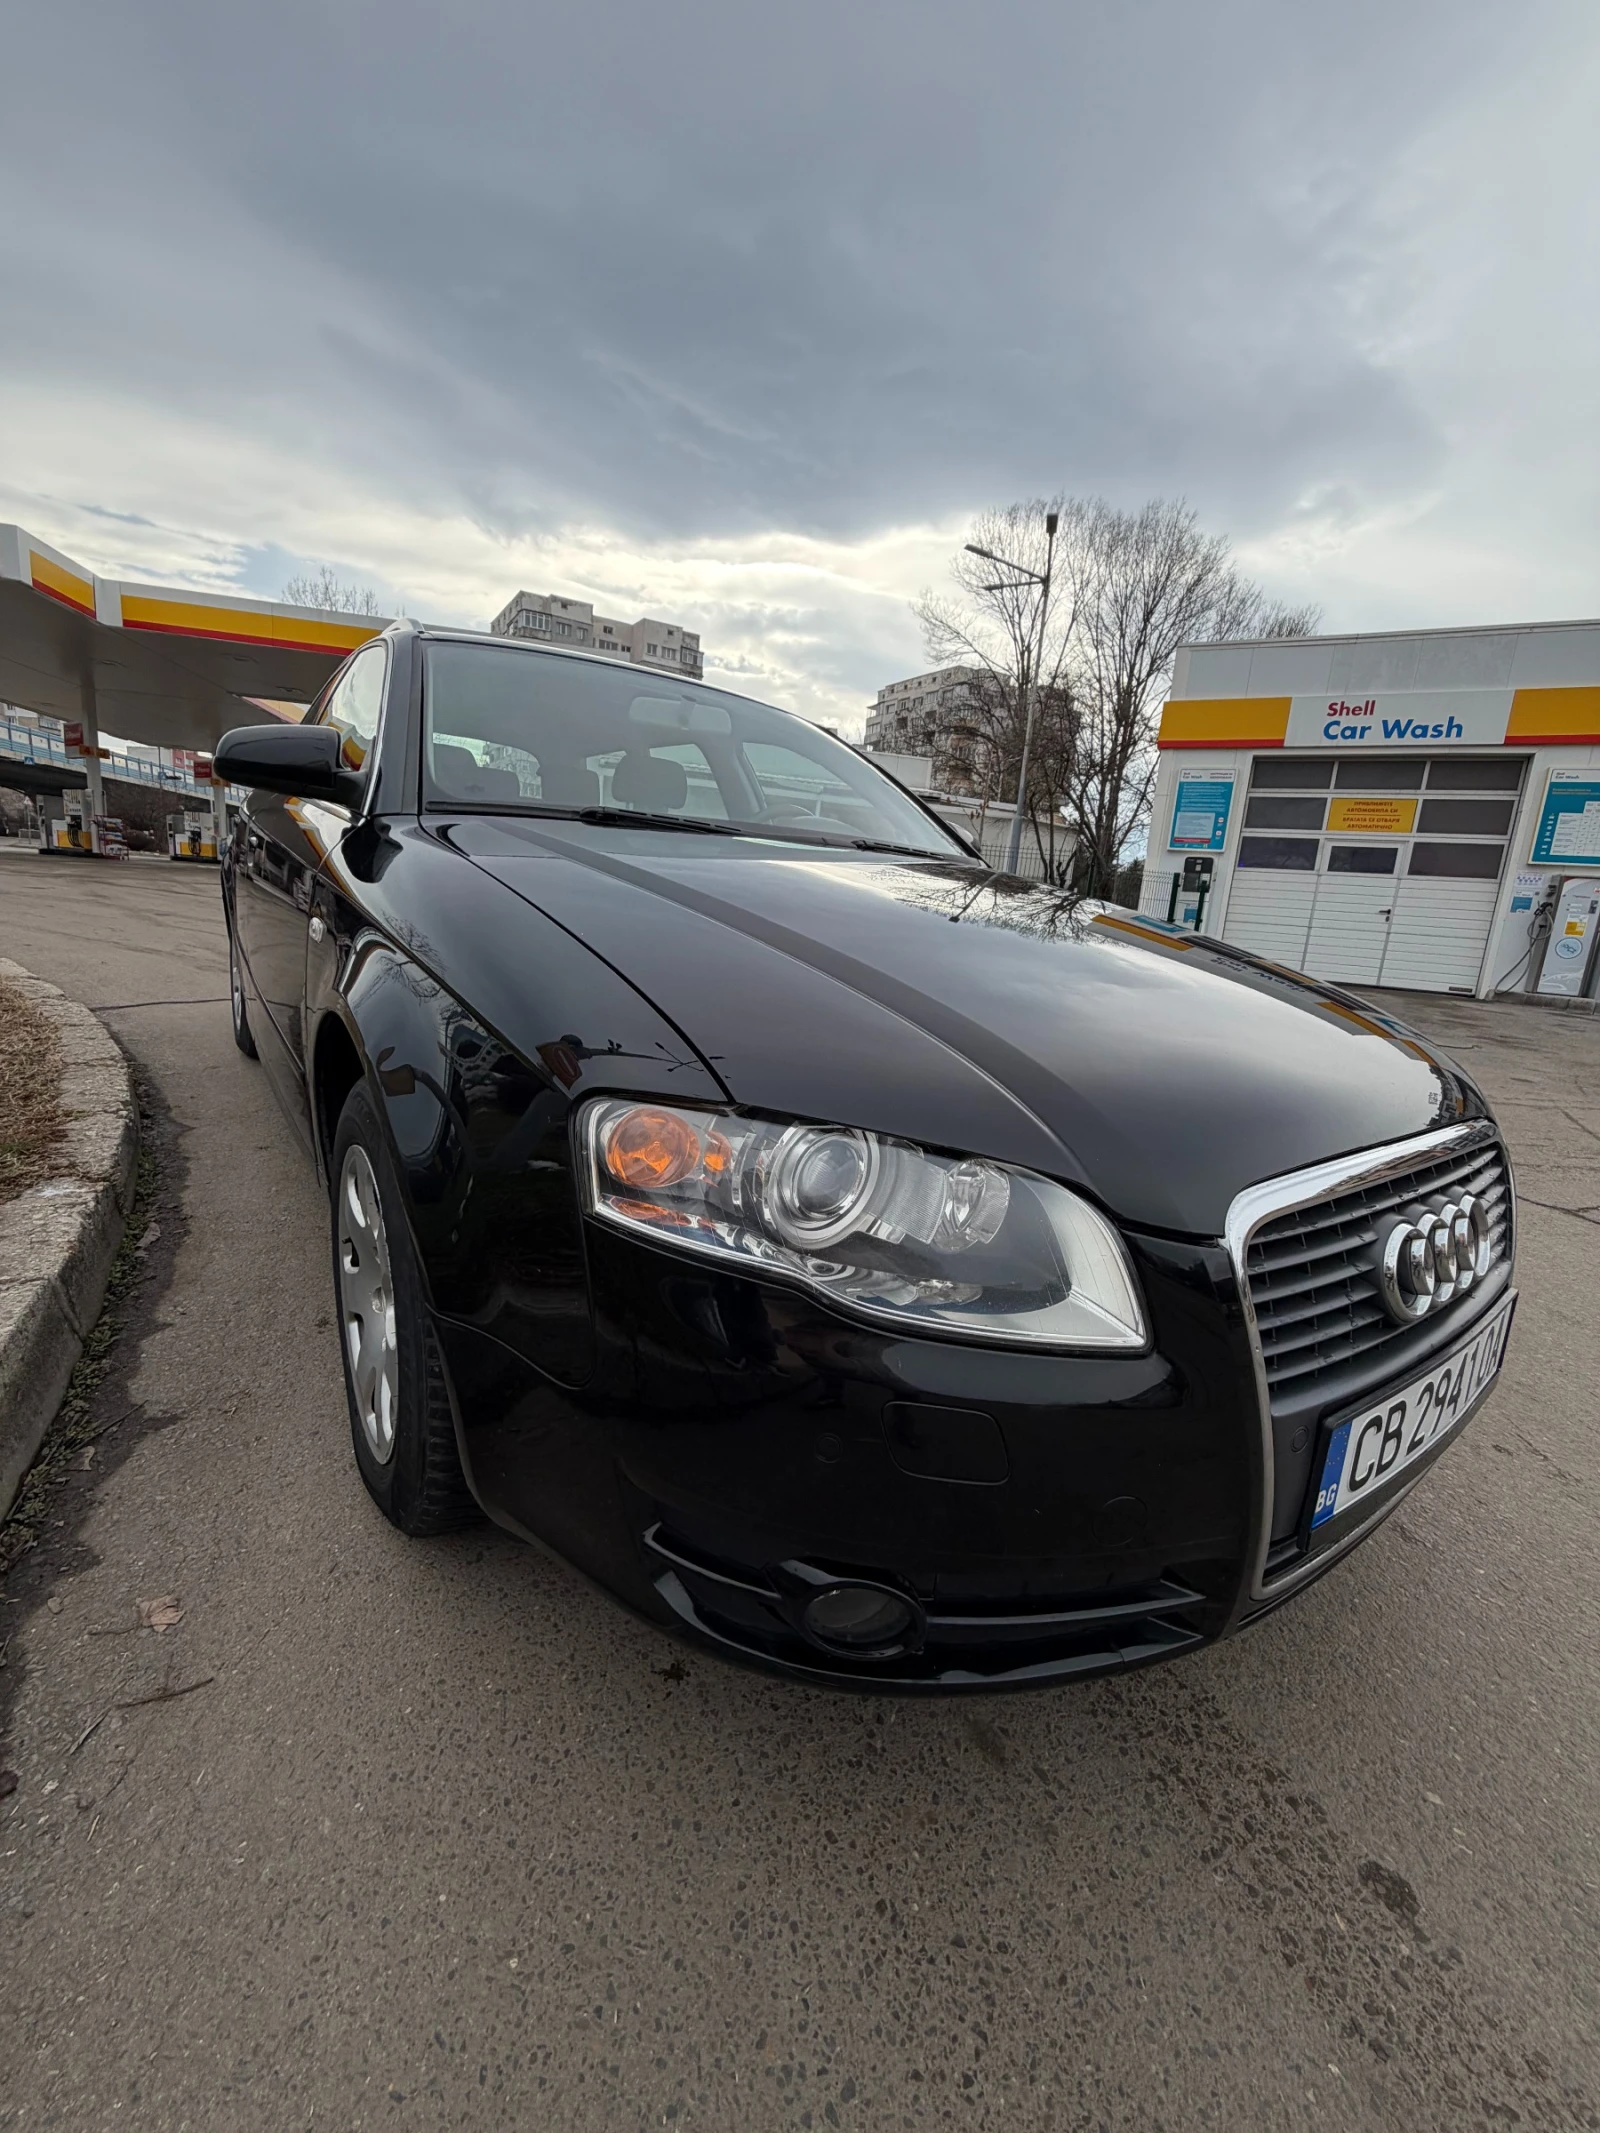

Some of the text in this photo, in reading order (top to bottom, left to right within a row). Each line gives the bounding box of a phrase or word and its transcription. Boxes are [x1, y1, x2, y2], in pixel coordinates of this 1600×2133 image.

[1327, 700, 1376, 717] Shell
[1323, 716, 1463, 740] Car Wash
[1315, 1483, 1338, 1513] BG
